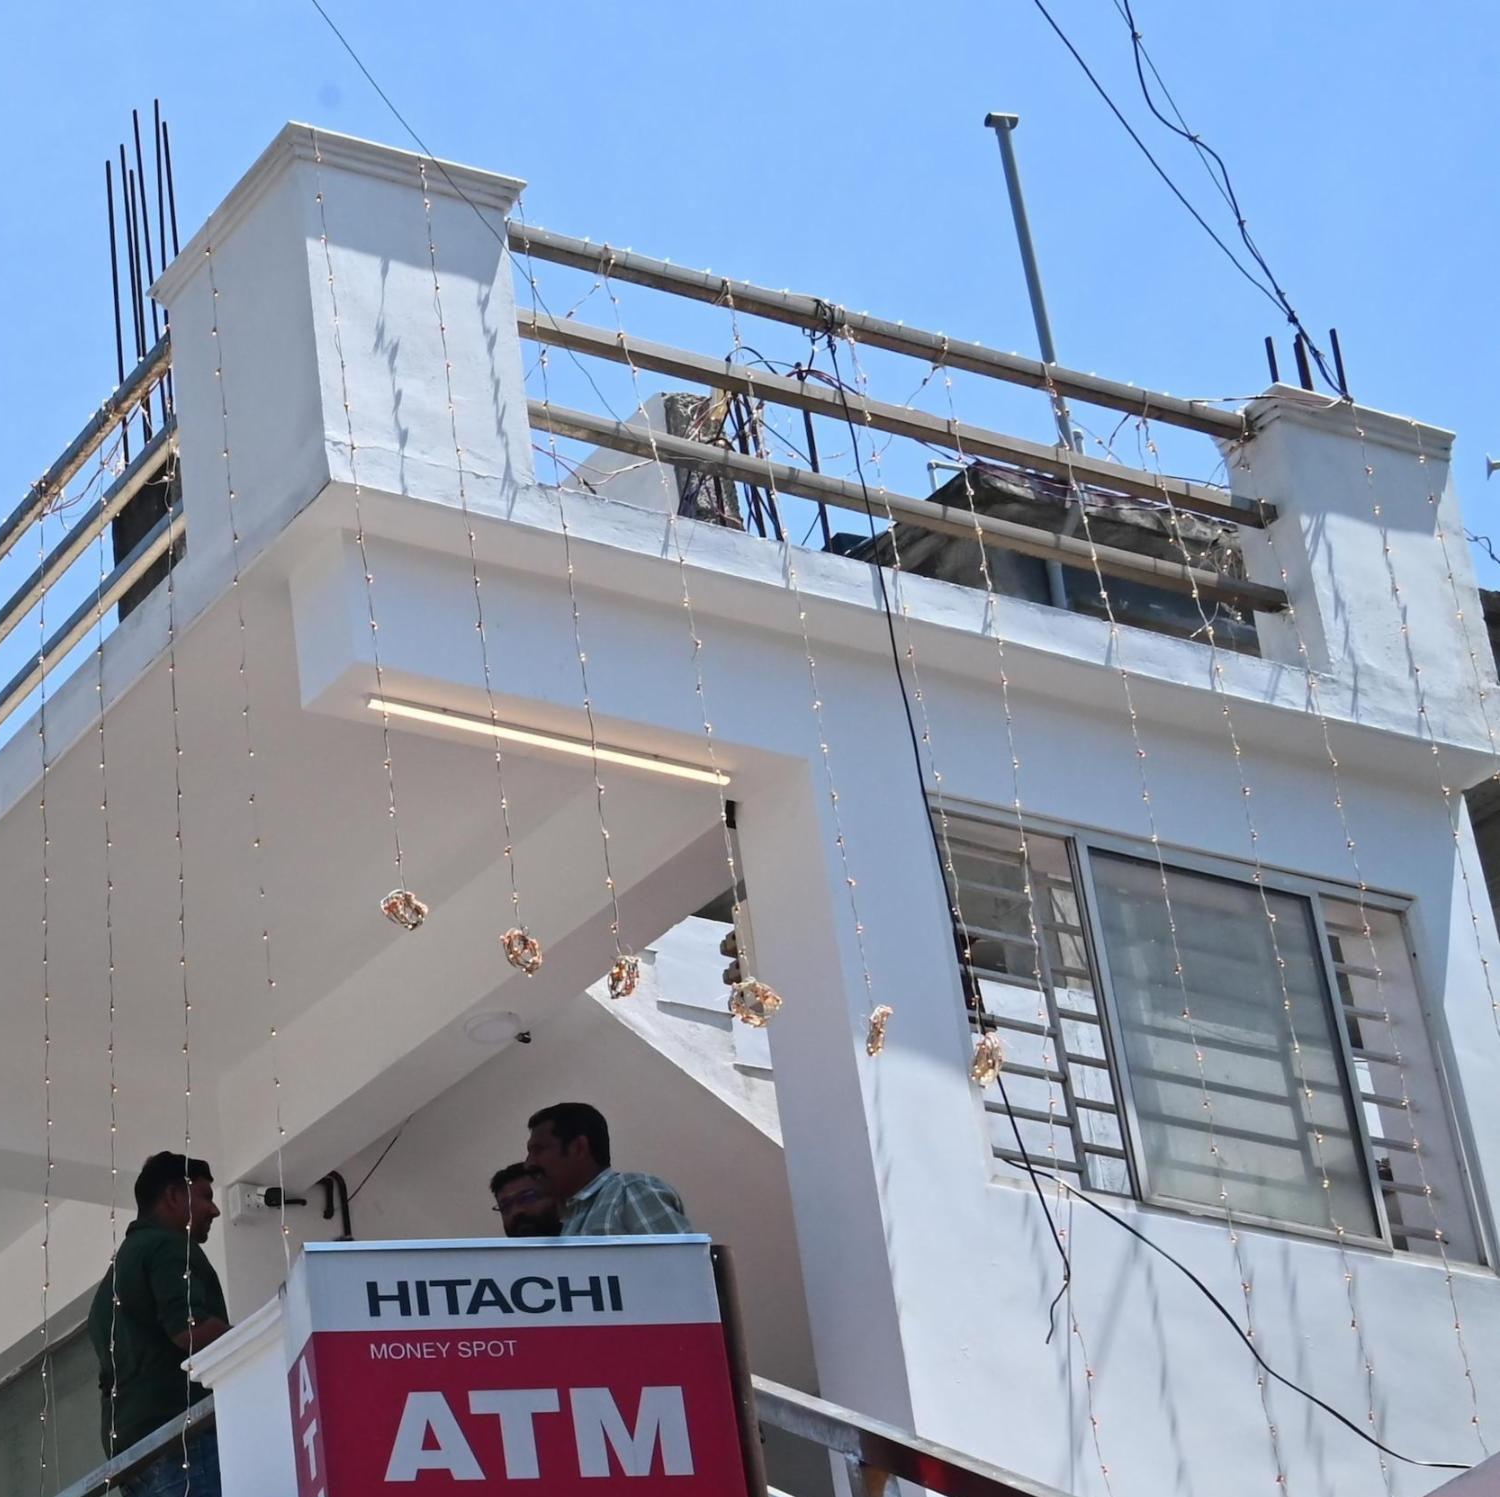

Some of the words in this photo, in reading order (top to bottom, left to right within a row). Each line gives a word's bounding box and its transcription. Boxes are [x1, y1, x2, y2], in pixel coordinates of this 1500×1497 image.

[366, 1275, 624, 1317] HITACHI
[369, 1341, 451, 1360] MONEY
[457, 1339, 518, 1358] SPOT
[384, 1386, 695, 1483] ATM
